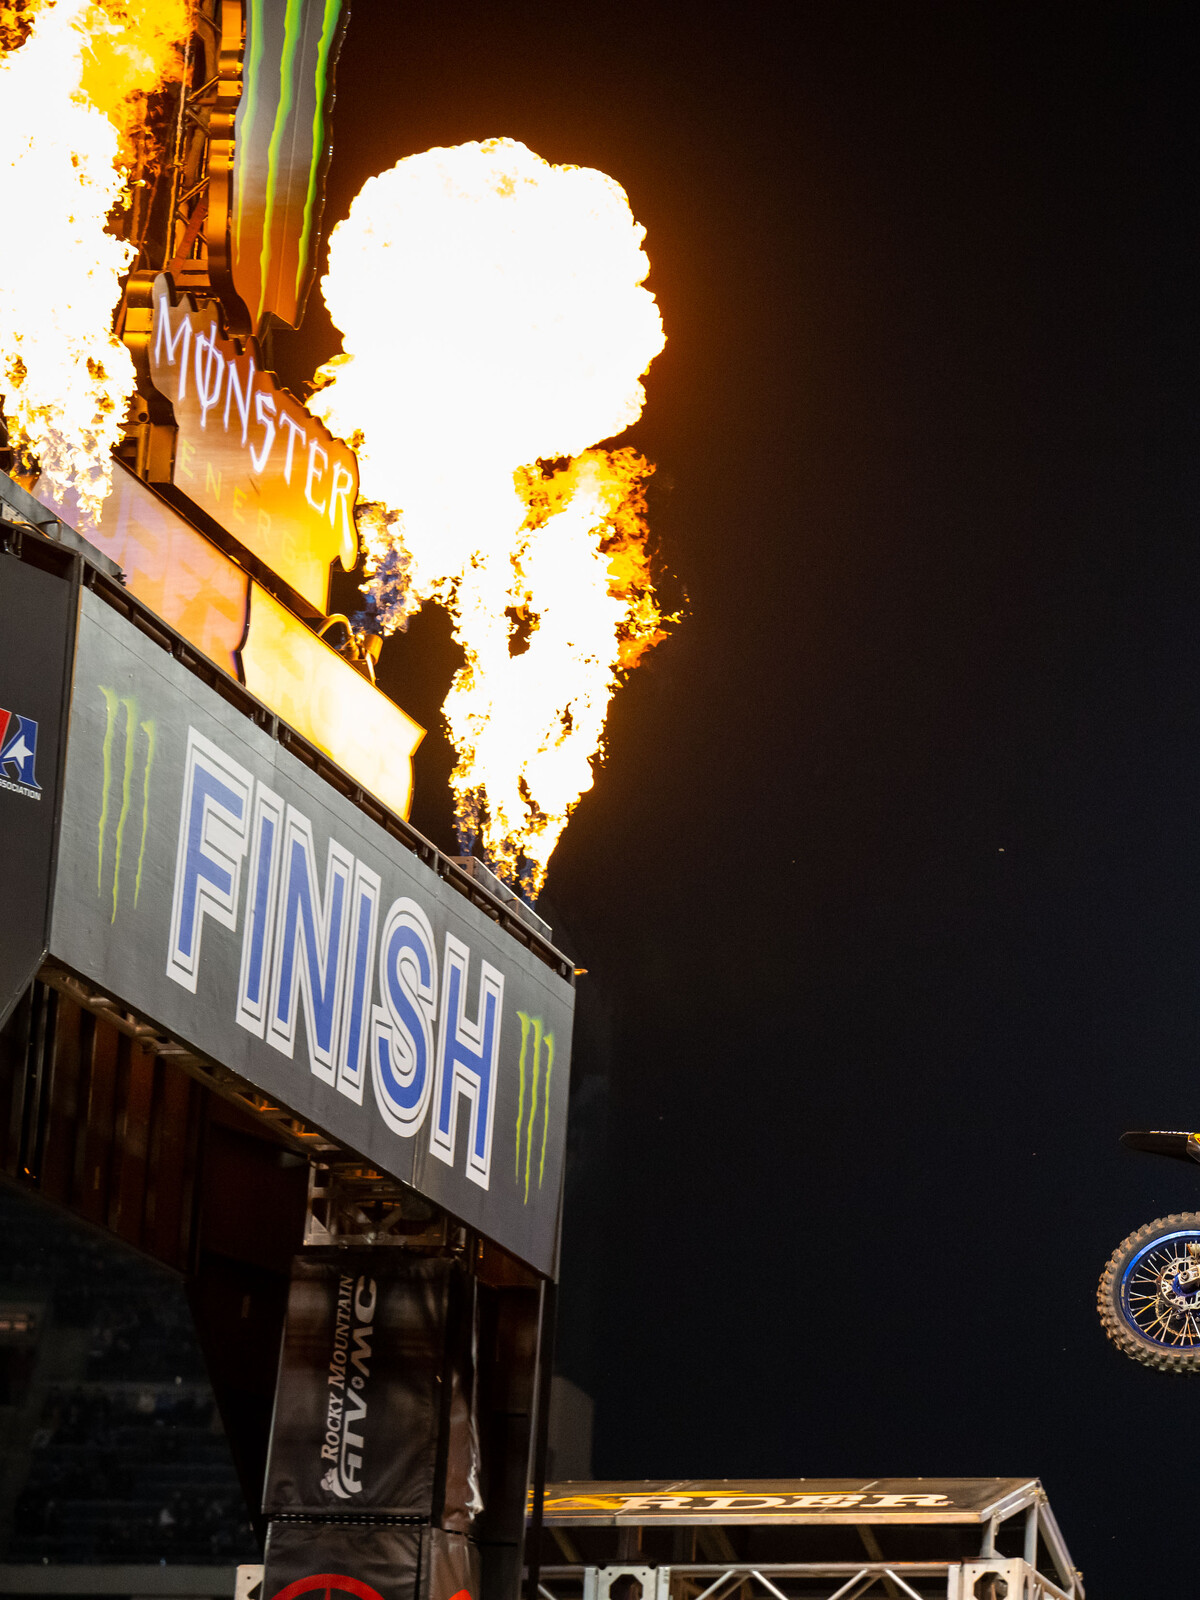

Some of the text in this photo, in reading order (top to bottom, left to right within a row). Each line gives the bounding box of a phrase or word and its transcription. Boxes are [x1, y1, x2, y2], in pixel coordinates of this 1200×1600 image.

[154, 293, 355, 553] MONSTER
[179, 439, 304, 570] ENERG
[166, 725, 504, 1190] FINISH
[320, 1274, 354, 1463] ROCKY MOUNTAIN
